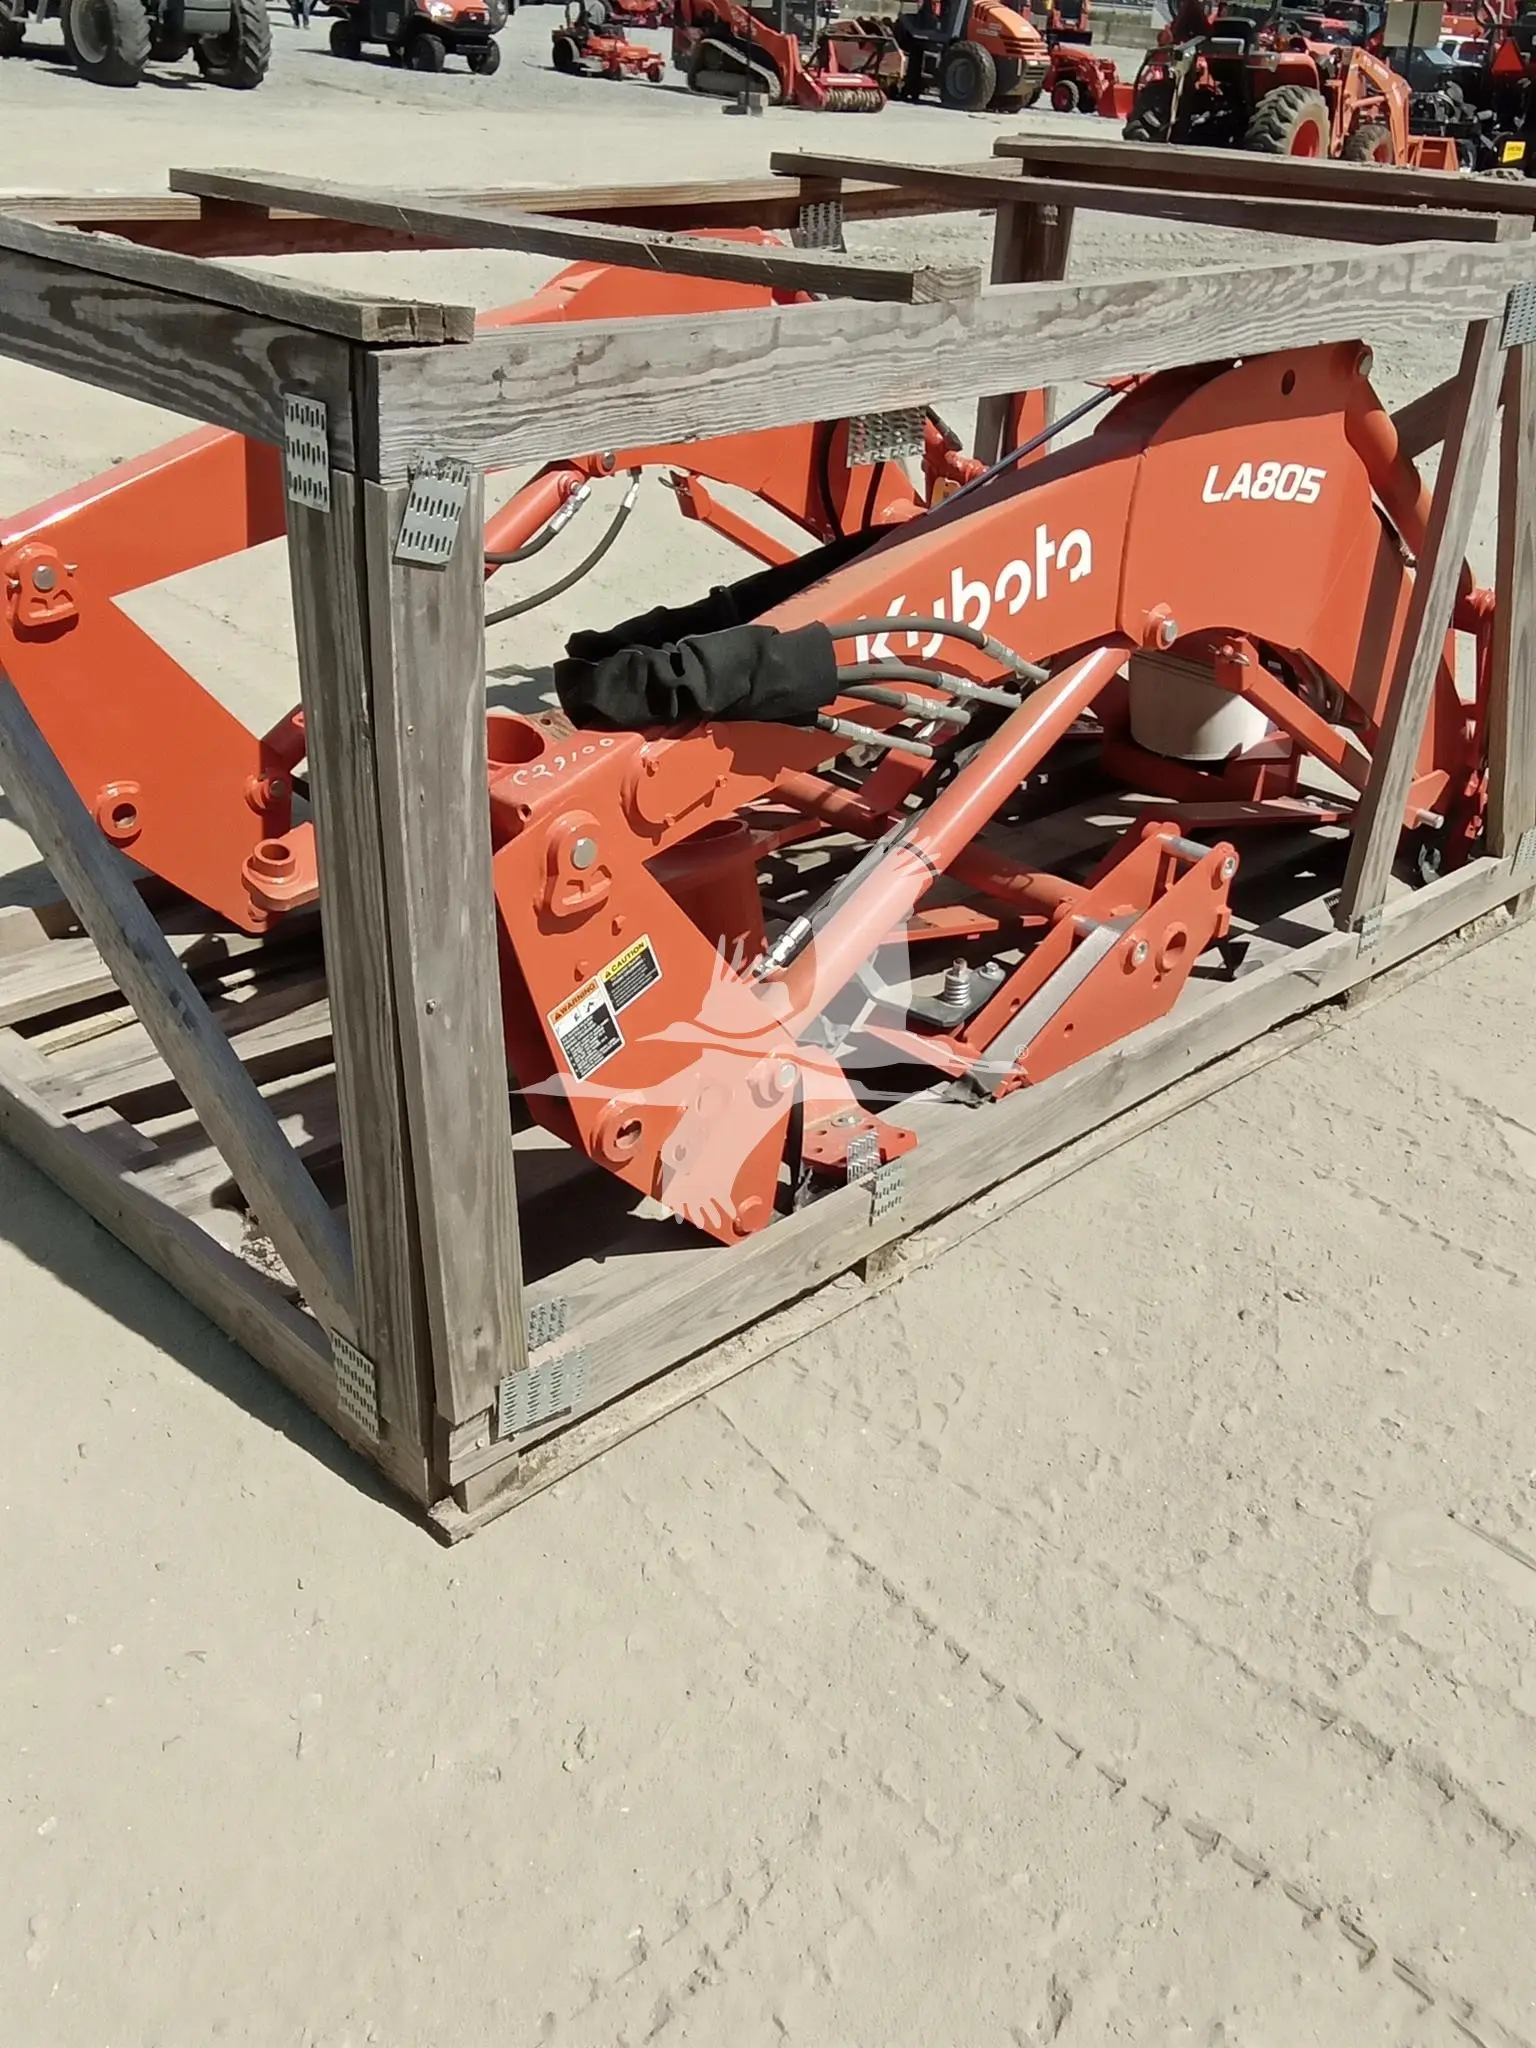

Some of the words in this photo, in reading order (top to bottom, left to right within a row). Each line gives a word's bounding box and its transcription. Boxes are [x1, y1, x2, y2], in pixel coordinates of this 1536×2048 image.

[1202, 461, 1327, 504] LA805
[855, 523, 1092, 663] Kubota
[611, 942, 645, 972] CAUTION
[561, 983, 597, 1015] WARNING
